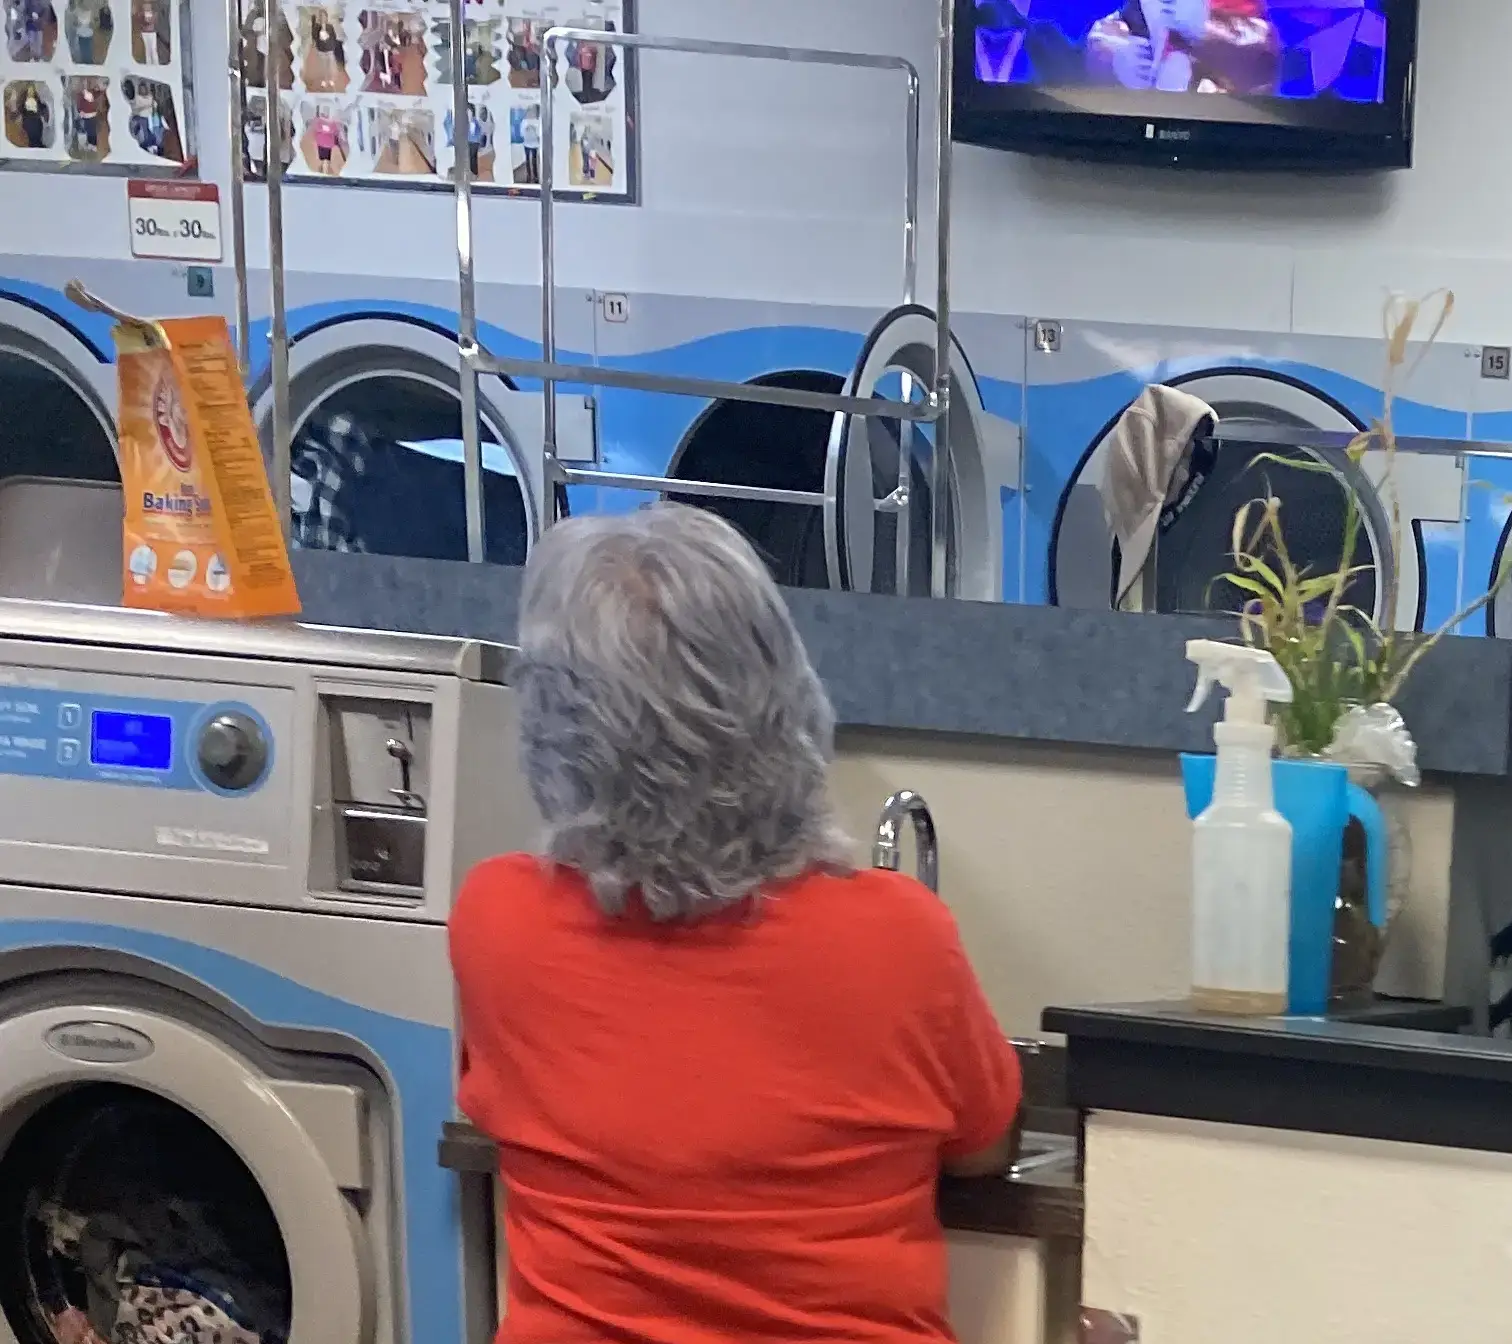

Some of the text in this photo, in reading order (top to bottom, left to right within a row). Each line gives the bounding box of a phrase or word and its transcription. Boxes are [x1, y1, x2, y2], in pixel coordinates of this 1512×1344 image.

[135, 217, 157, 236] 30
[179, 219, 202, 239] 30
[609, 301, 622, 315] 11
[1041, 328, 1056, 343] 13
[1488, 355, 1504, 370] 15
[143, 492, 193, 516] Baking
